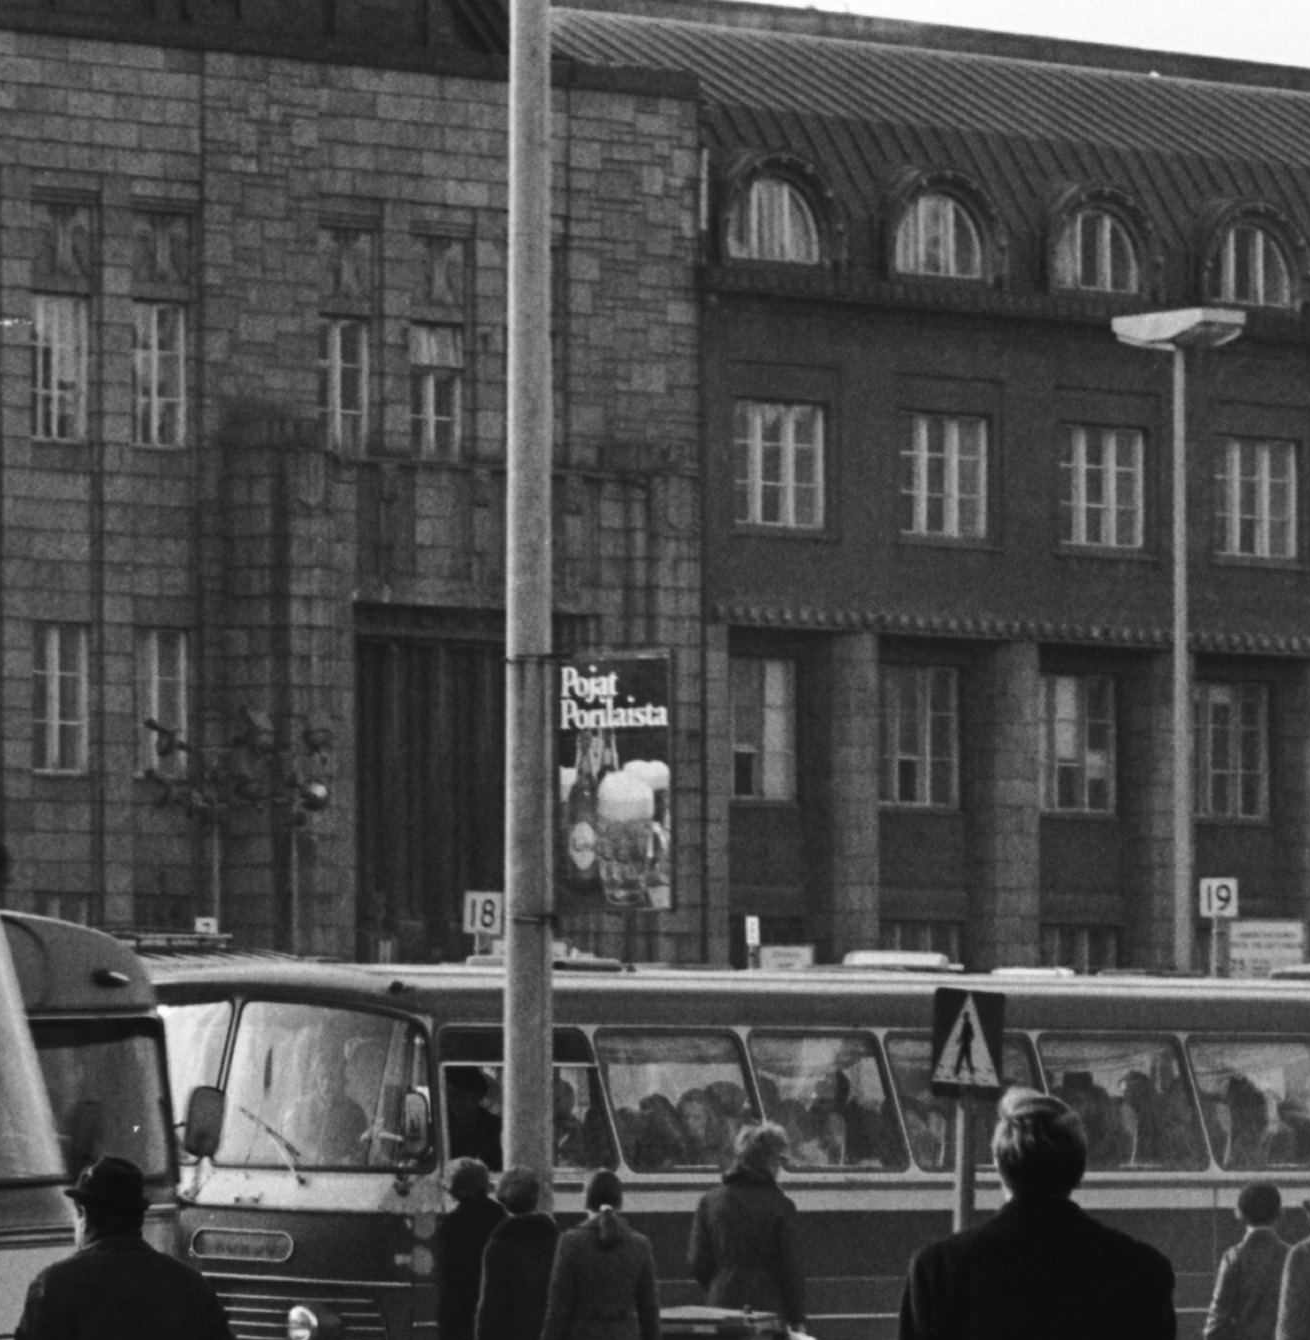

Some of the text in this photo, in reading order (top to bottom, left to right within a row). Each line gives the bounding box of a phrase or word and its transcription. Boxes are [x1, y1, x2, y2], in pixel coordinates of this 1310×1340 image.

[560, 665, 619, 704] Pojat
[560, 695, 669, 730] Porilaista
[470, 898, 496, 928] 18
[1207, 884, 1232, 912] 19
